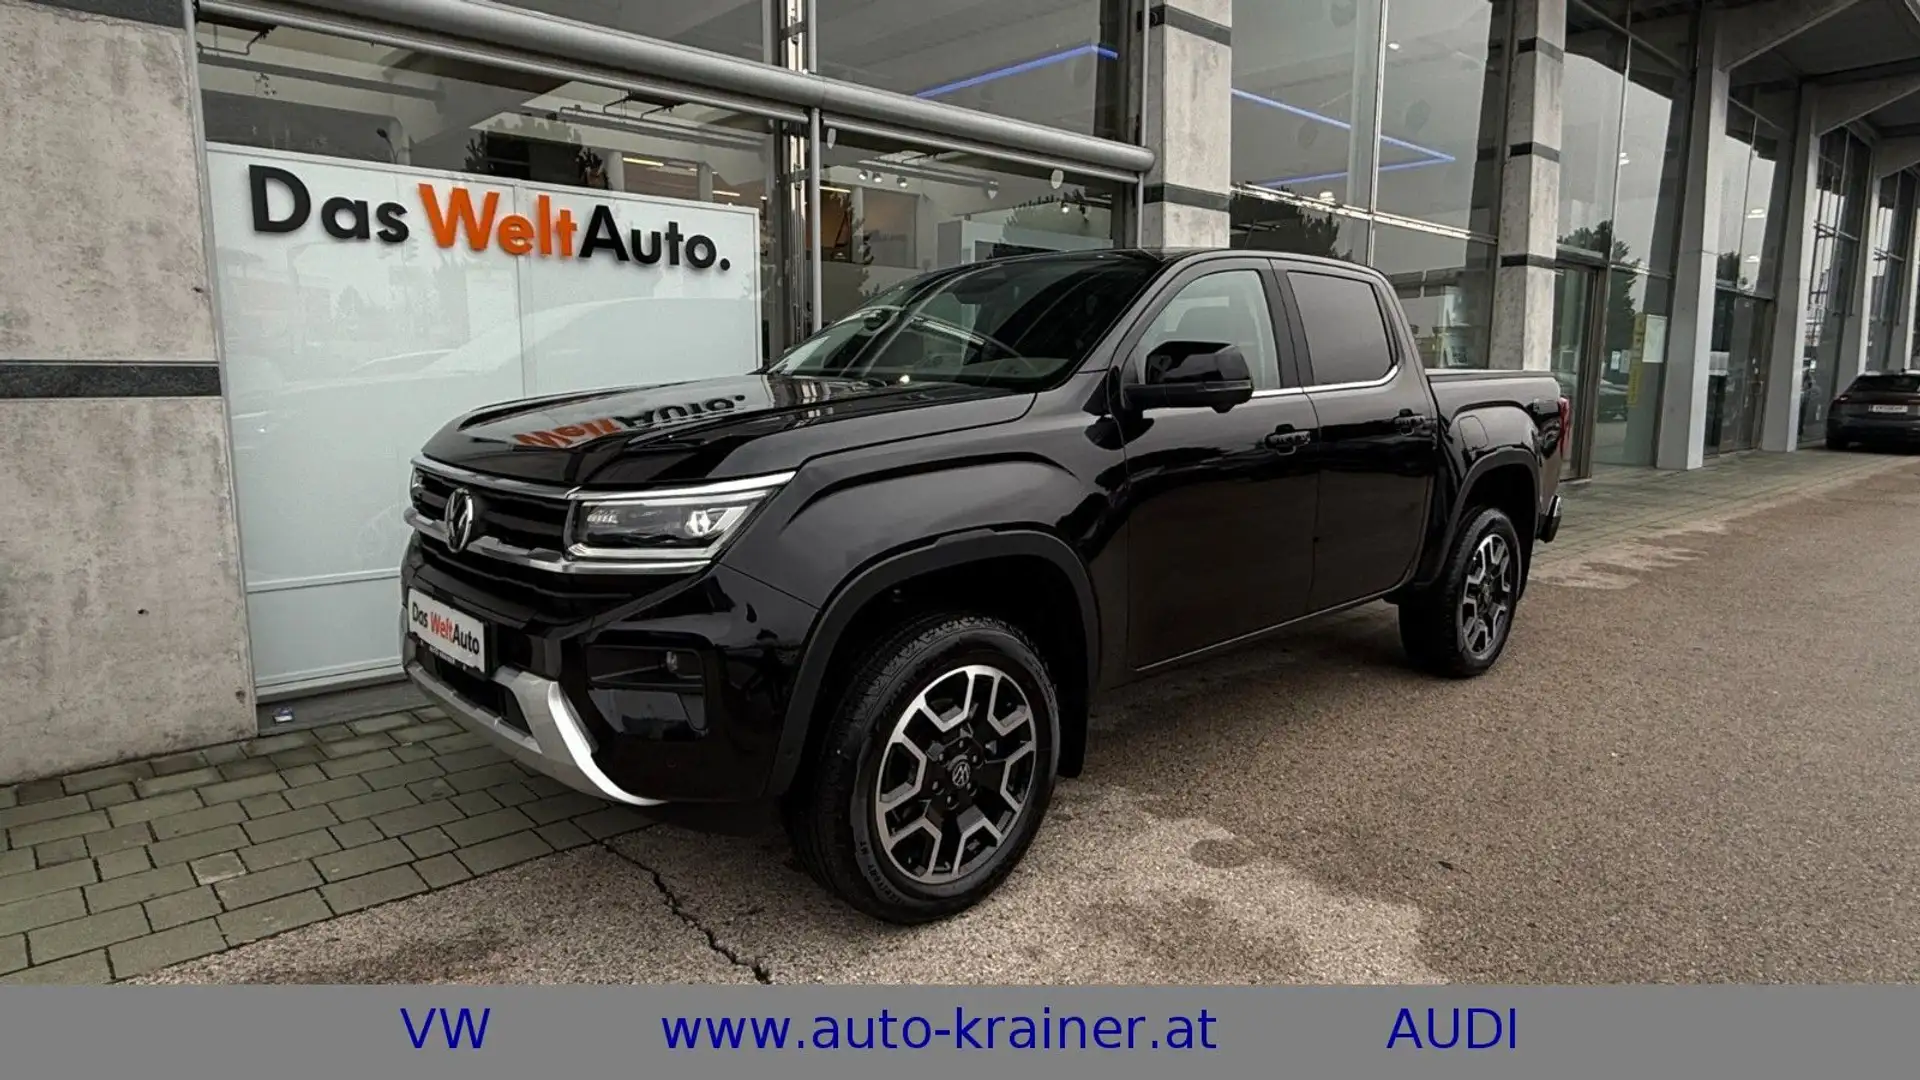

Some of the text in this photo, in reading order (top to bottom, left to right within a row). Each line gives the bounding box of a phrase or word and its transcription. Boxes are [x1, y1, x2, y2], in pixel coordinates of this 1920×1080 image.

[249, 164, 732, 271] Das WeltAuto.
[412, 601, 428, 629] Das
[430, 611, 480, 655] WeltAuto
